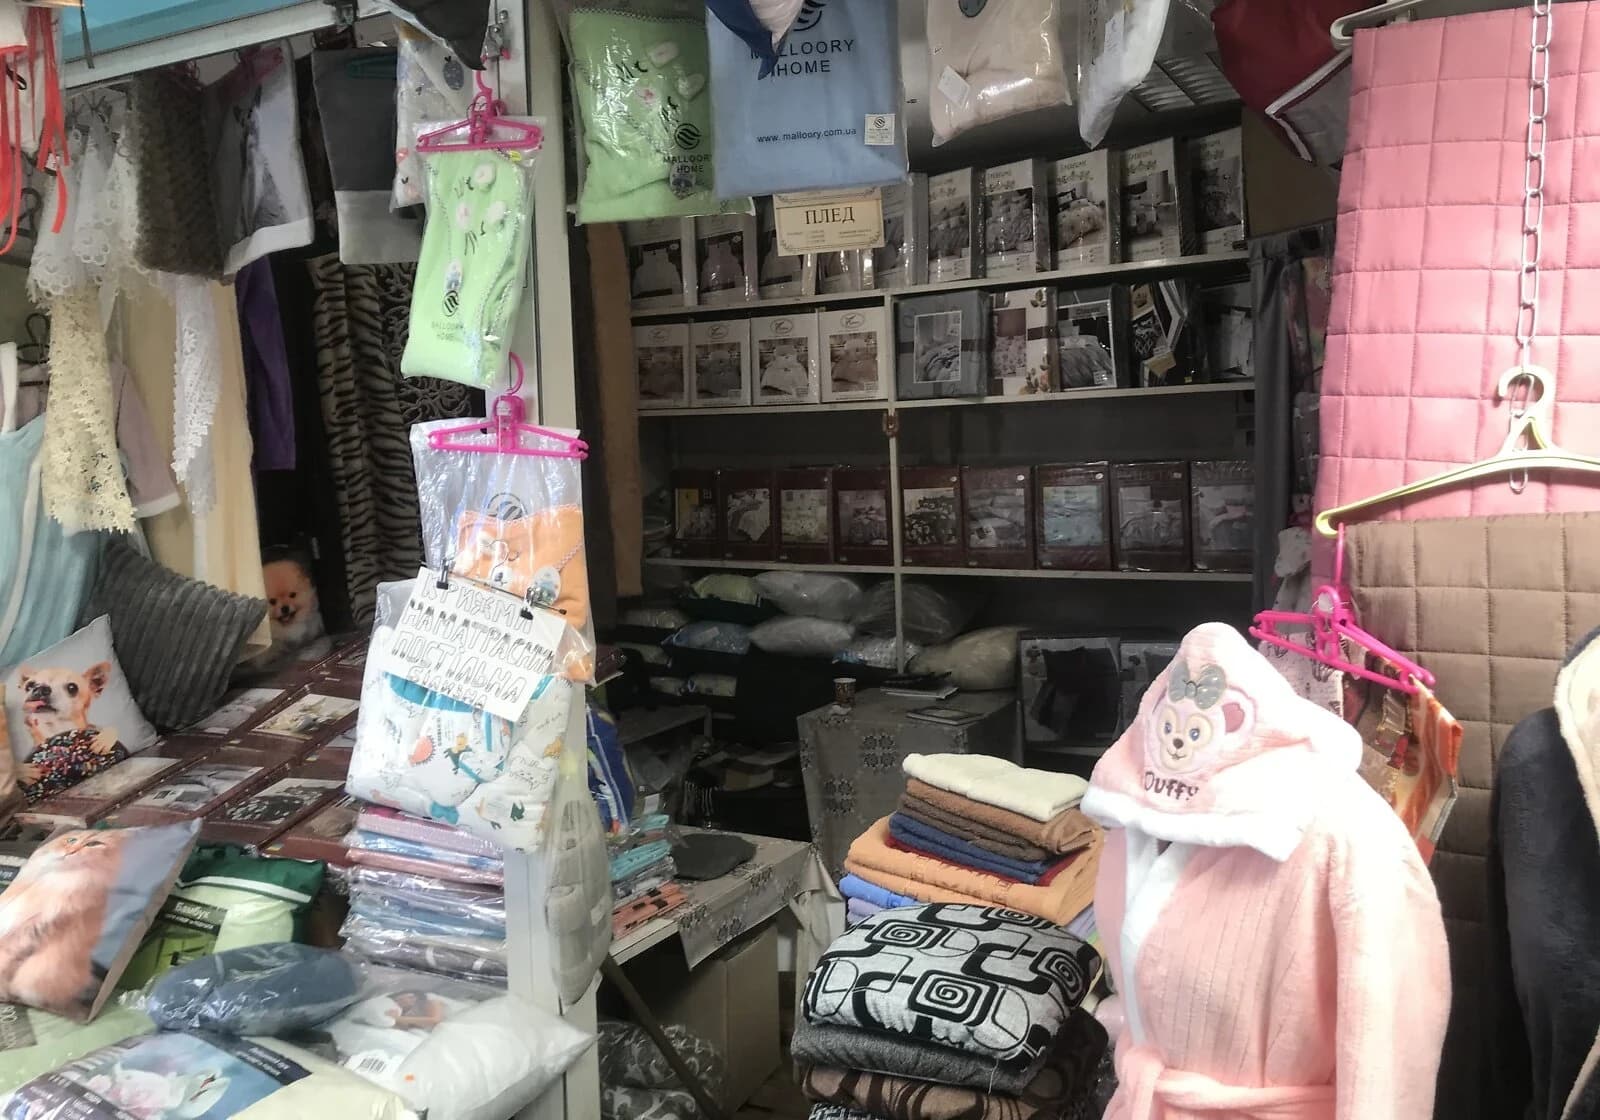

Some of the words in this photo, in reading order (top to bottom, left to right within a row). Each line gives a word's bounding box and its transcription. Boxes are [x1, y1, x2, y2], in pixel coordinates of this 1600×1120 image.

[777, 59, 832, 77] HOME
[677, 164, 704, 174] HOME
[805, 206, 856, 225] ПЛЕД
